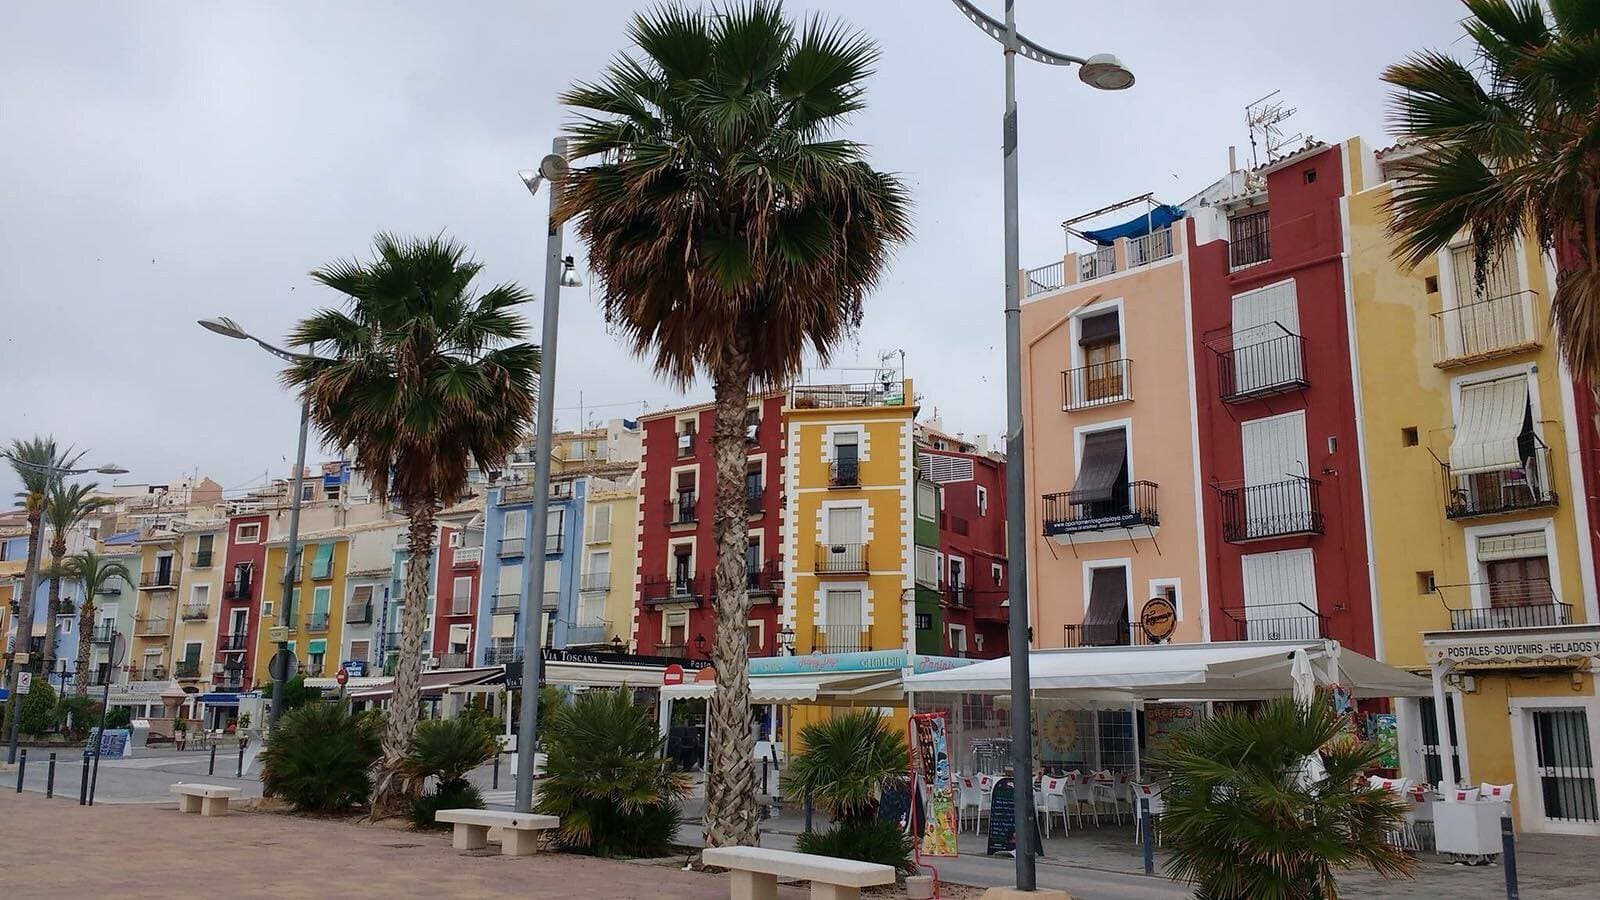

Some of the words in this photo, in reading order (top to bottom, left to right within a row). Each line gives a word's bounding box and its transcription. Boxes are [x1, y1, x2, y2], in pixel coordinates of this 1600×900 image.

[1494, 643, 1543, 655] SOUVENIRS
[1550, 641, 1592, 653] HELADOS
[1593, 640, 1600, 651] Y
[542, 648, 557, 661] VIA
[561, 650, 598, 664] TOSCANA
